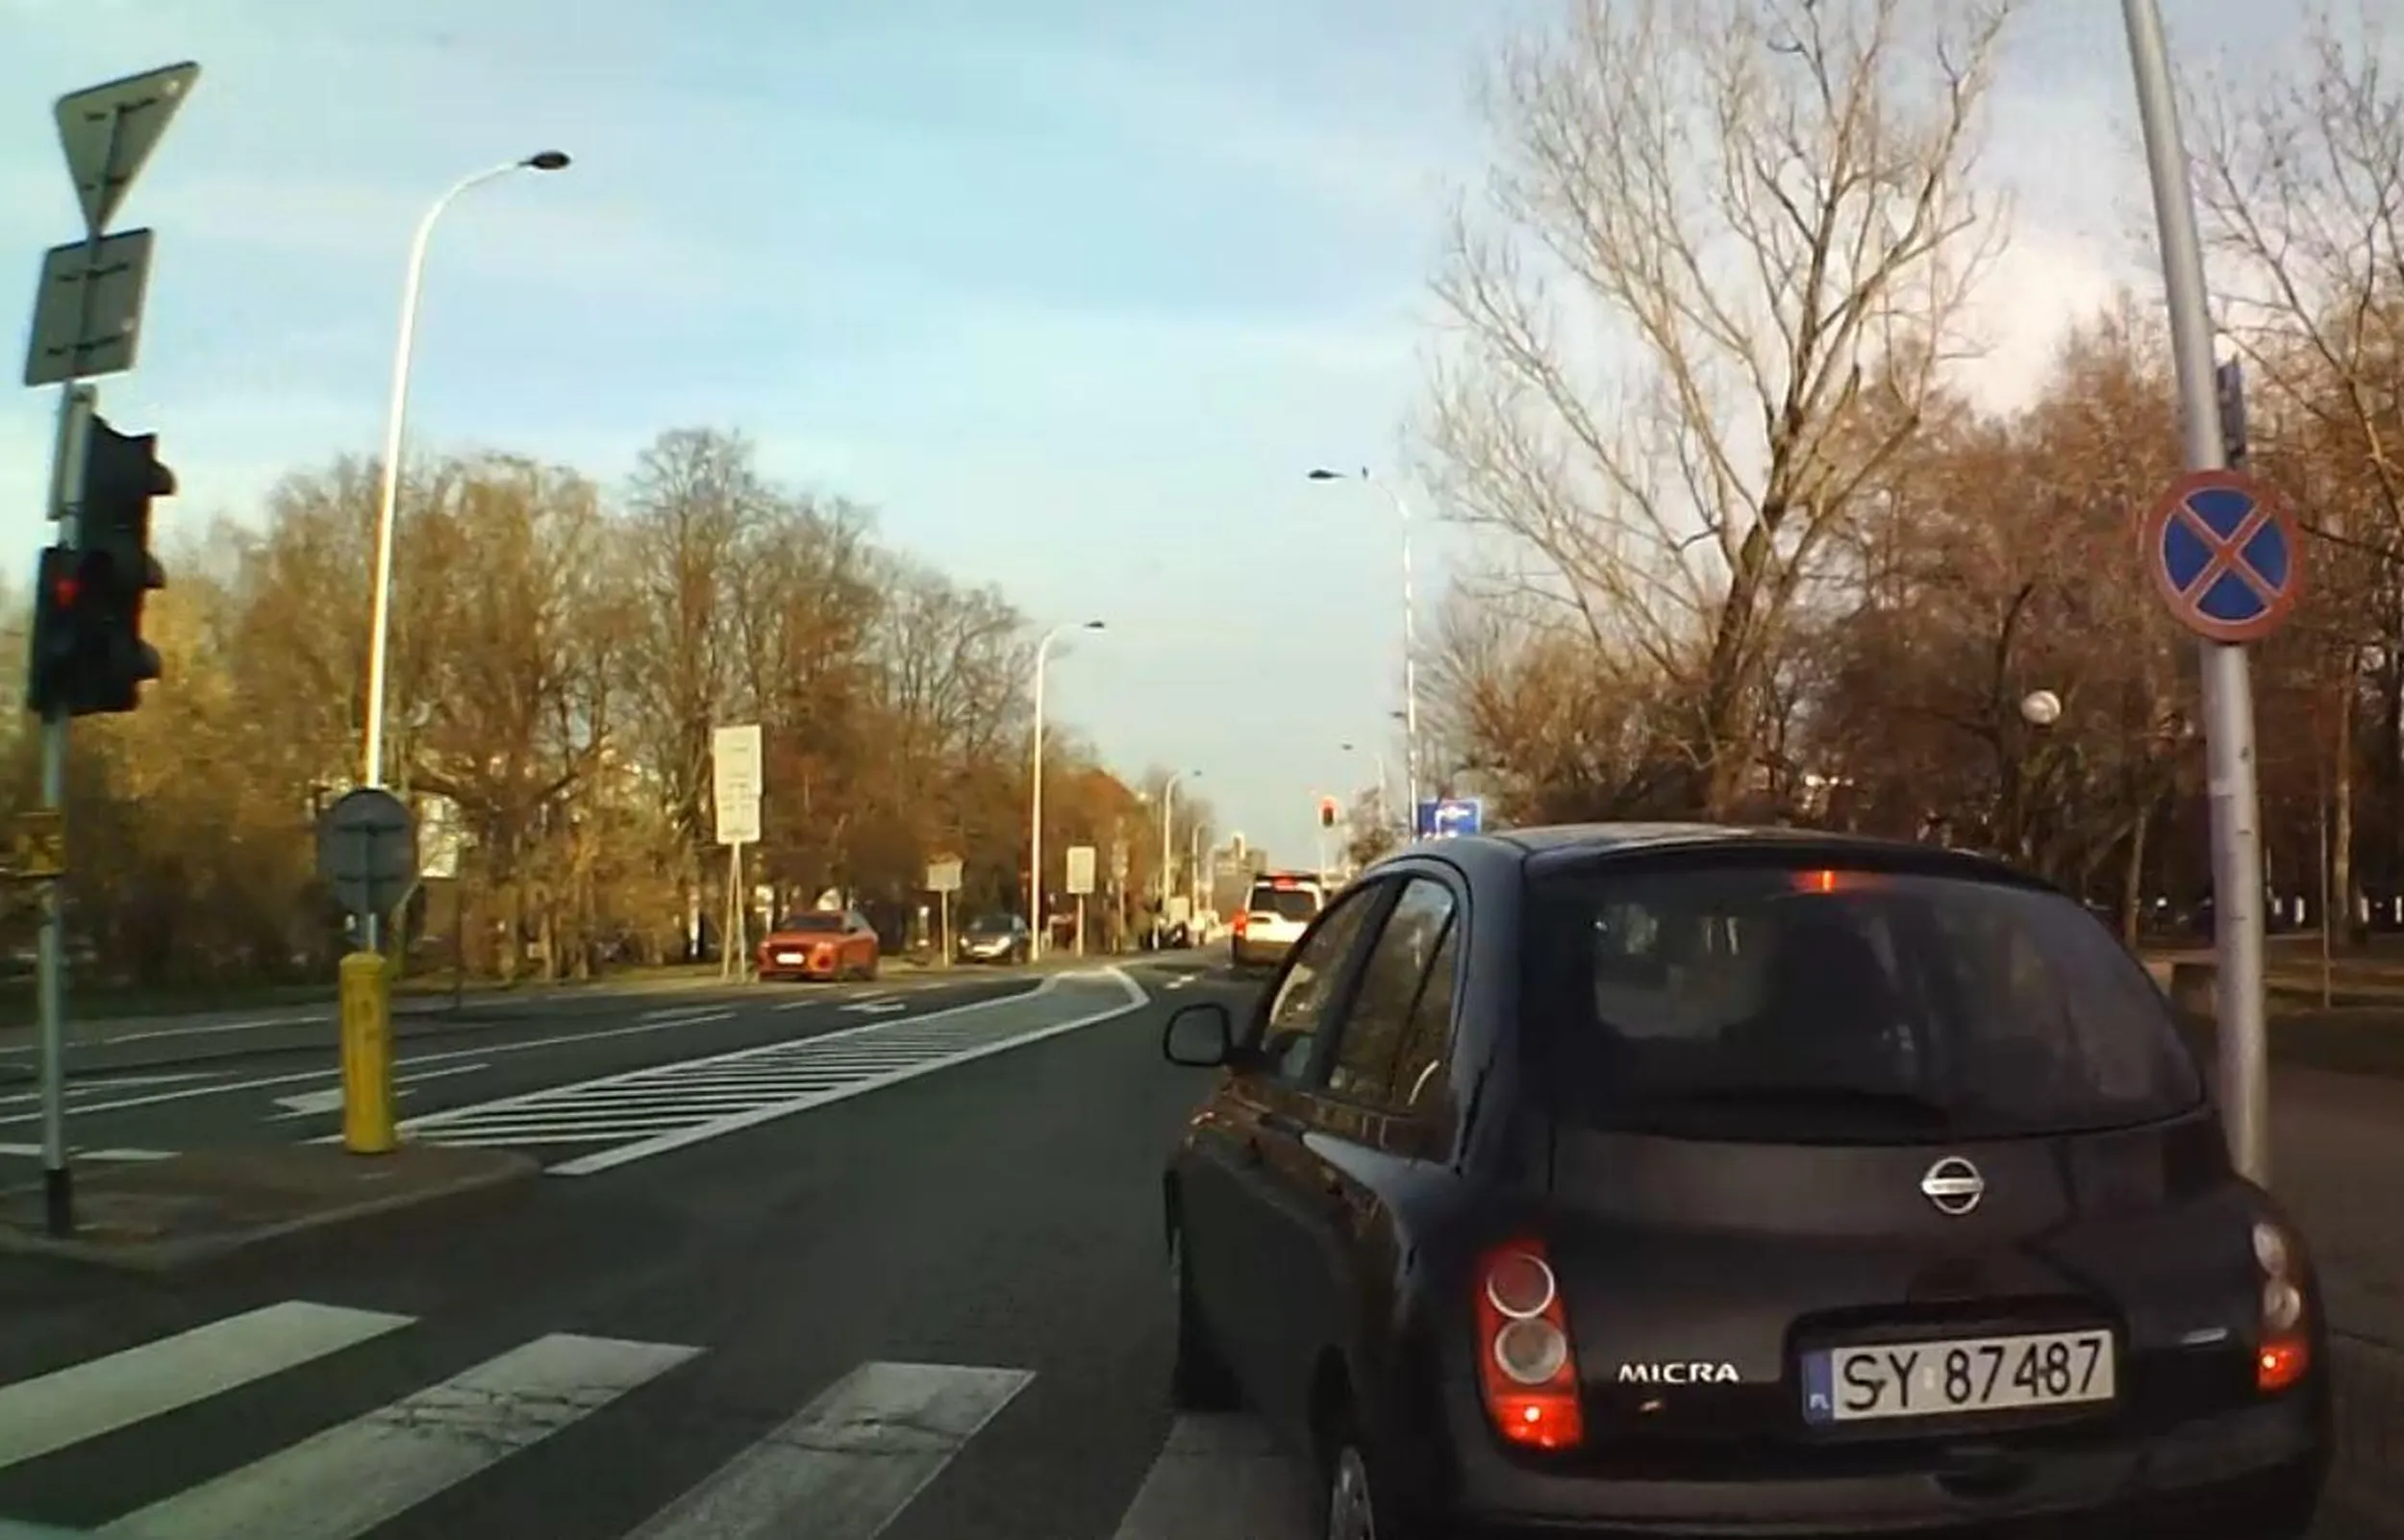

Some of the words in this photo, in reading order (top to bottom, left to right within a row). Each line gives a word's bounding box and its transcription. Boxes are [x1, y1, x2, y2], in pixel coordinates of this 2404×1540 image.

[1617, 1361, 1740, 1384] MICRA
[1842, 1351, 1919, 1411] SY
[1944, 1338, 2103, 1403] 87487
